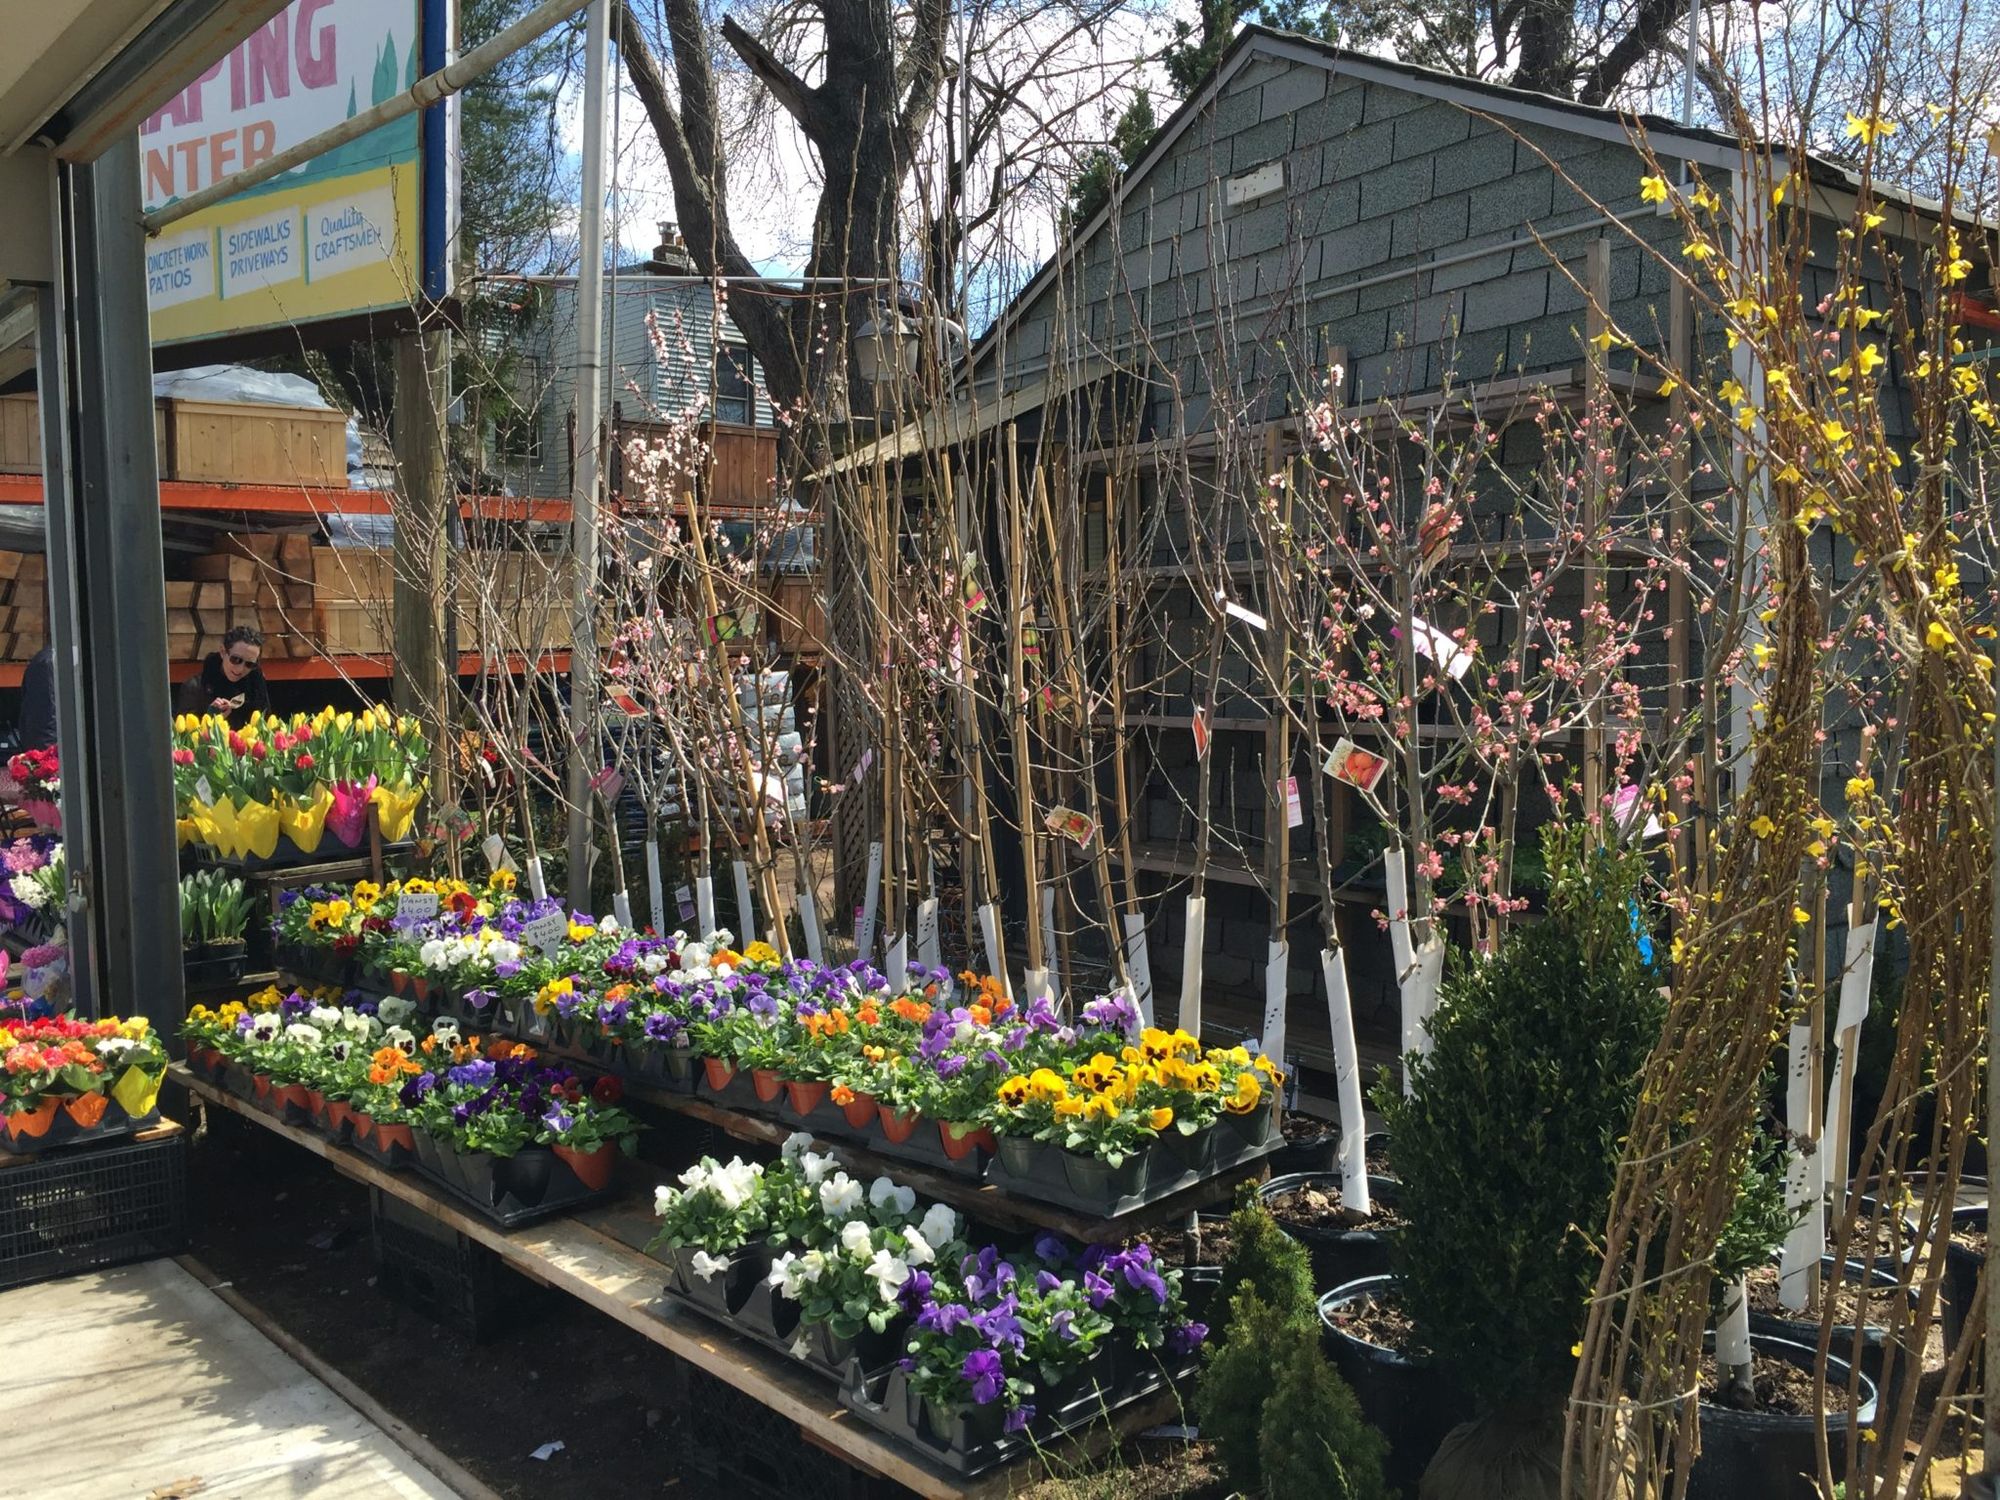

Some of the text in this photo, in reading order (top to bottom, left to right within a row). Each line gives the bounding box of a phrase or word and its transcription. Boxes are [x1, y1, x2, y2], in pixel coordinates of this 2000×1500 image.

[229, 220, 291, 255] SIDEWALKS
[321, 208, 363, 237] Quality
[184, 241, 209, 263] WORK
[315, 227, 381, 262] CRAFTSMEN
[230, 247, 288, 278] DRIVEWAYS
[150, 268, 192, 295] PATIOS
